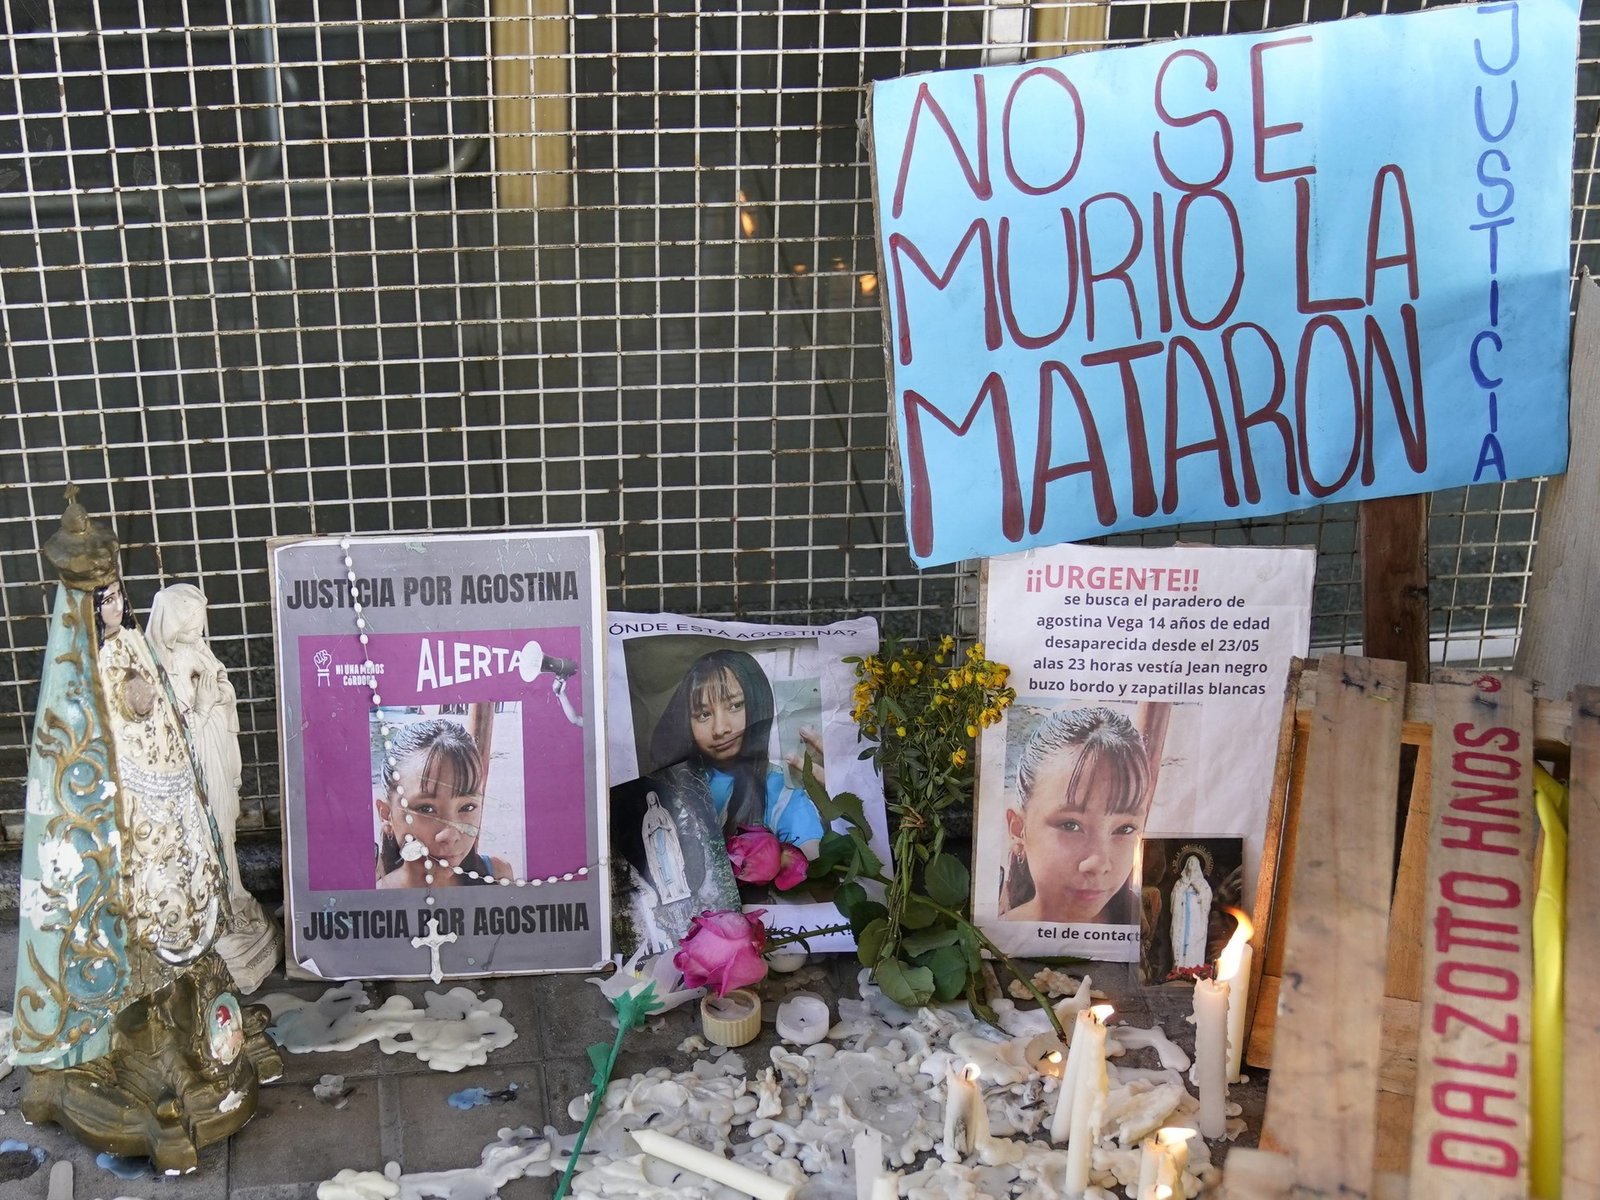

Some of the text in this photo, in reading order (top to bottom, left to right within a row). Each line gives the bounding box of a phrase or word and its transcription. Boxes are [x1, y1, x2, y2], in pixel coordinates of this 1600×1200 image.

[894, 36, 1317, 219] NO SE
[1470, 2, 1519, 482] JUSTICIA
[889, 164, 1420, 365] MURIO LA
[903, 304, 1428, 558] MATARON
[287, 571, 579, 610] JUSTICIA POR AGOSTINA
[1026, 564, 1199, 593] ¡¡URGENTE!!
[1064, 592, 1245, 610] se busca el paradero de
[609, 622, 668, 636] ÓNDE
[736, 629, 858, 639] AGOSTINA?
[1036, 615, 1270, 632] agostina Vega 14 años de edad
[1044, 636, 1259, 653] desaparecida desde el 23/05
[416, 638, 522, 692] ALERTA
[1033, 658, 1268, 677] alas 23 horas vestía Jean negro
[1029, 677, 1266, 697] buzo bordo y zapatillas blancas
[303, 902, 590, 941] JUSTICIA POR AGOSTINA
[1037, 927, 1140, 942] tel de contact
[1427, 721, 1523, 1178] DALZOTTO HNOS
